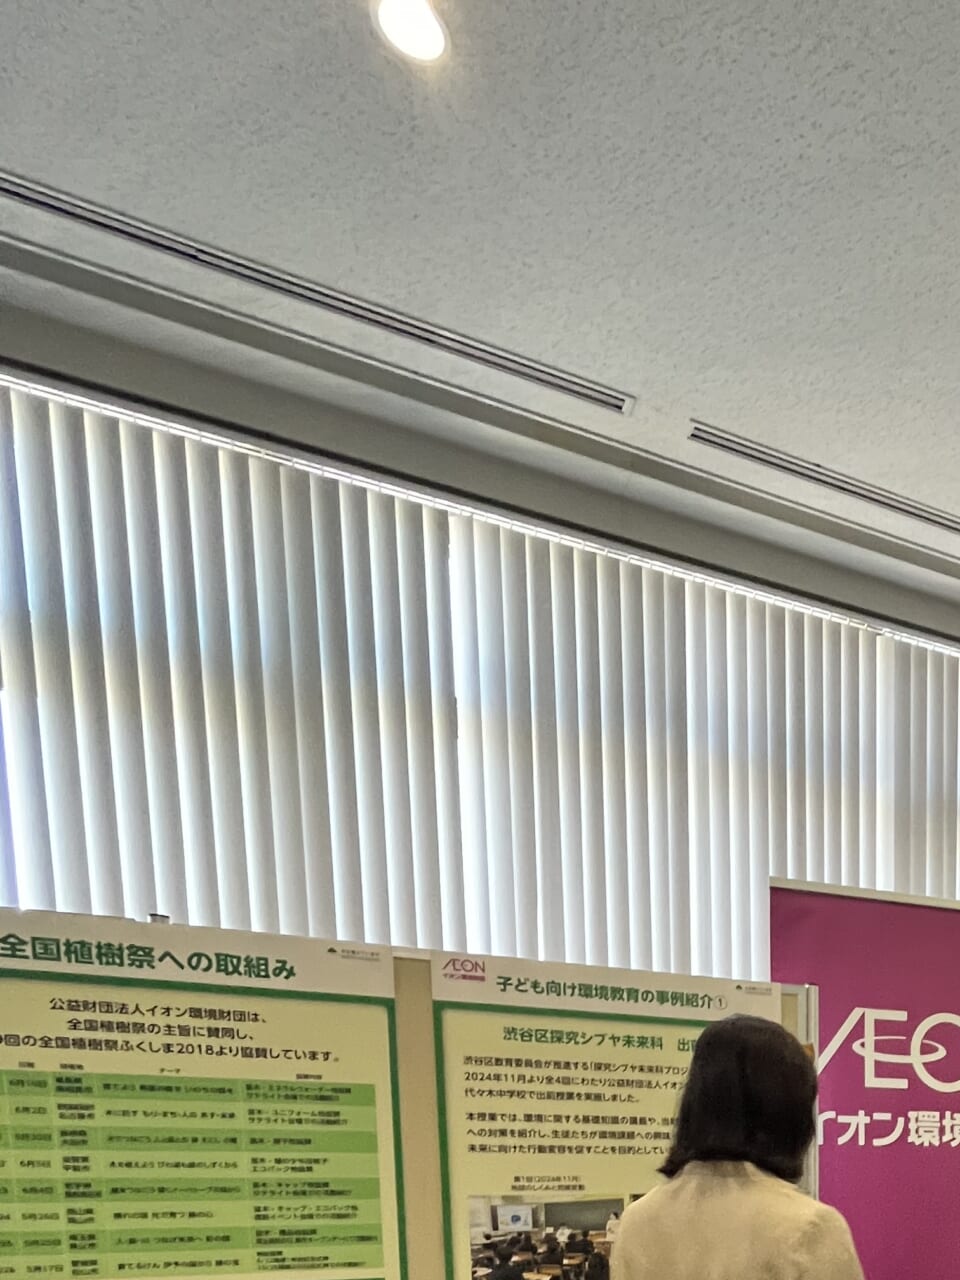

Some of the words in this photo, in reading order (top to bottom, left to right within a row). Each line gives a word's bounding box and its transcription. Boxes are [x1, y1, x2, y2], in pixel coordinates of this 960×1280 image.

[0, 933, 296, 980] 全国植樹祭への取組み
[49, 997, 267, 1024] 公益財団法人イオン環境財団は、
[503, 1026, 663, 1051] 渋谷区探究シブヤ未来科
